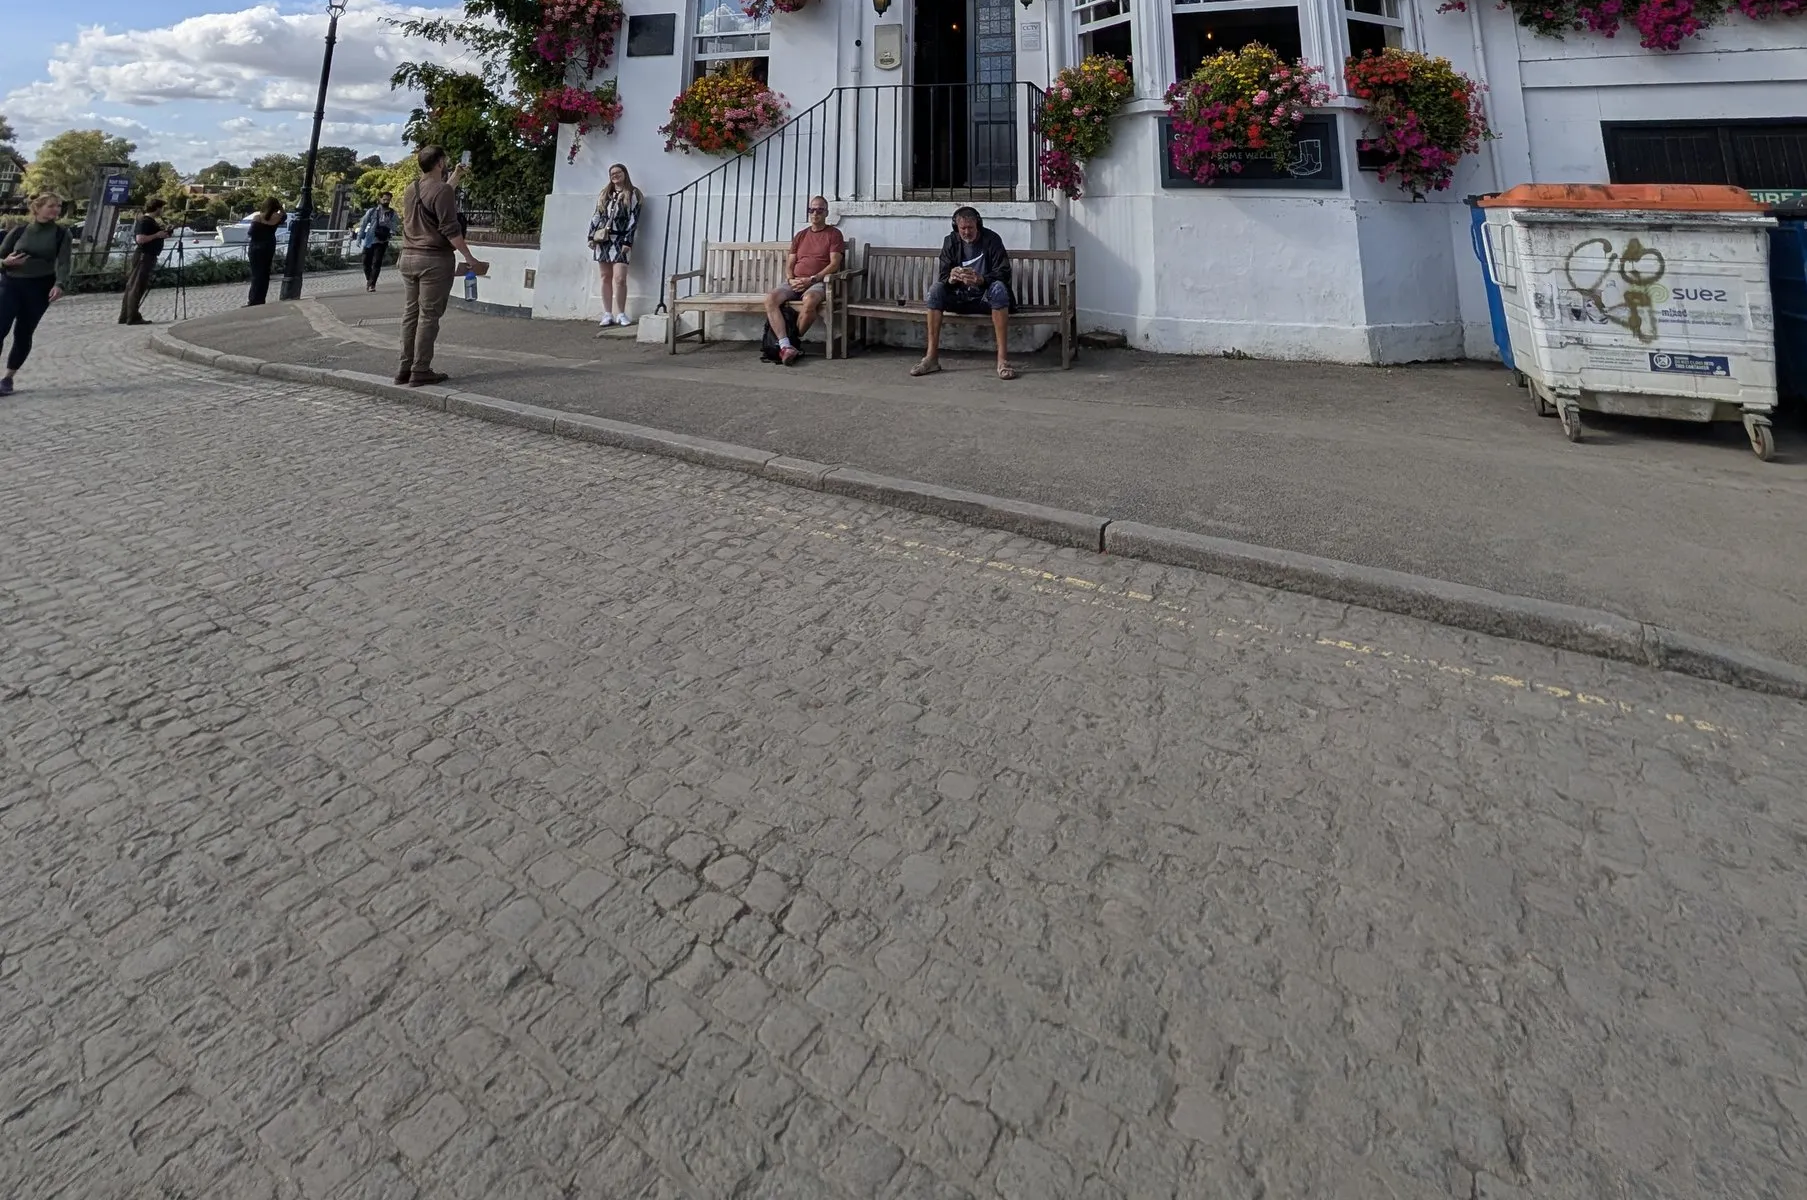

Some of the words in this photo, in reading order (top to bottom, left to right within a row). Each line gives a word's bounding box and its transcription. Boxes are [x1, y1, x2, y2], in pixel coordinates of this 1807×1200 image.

[1217, 151, 1242, 160] SOME
[1245, 151, 1277, 160] WELLIE
[1672, 287, 1728, 302] suez
